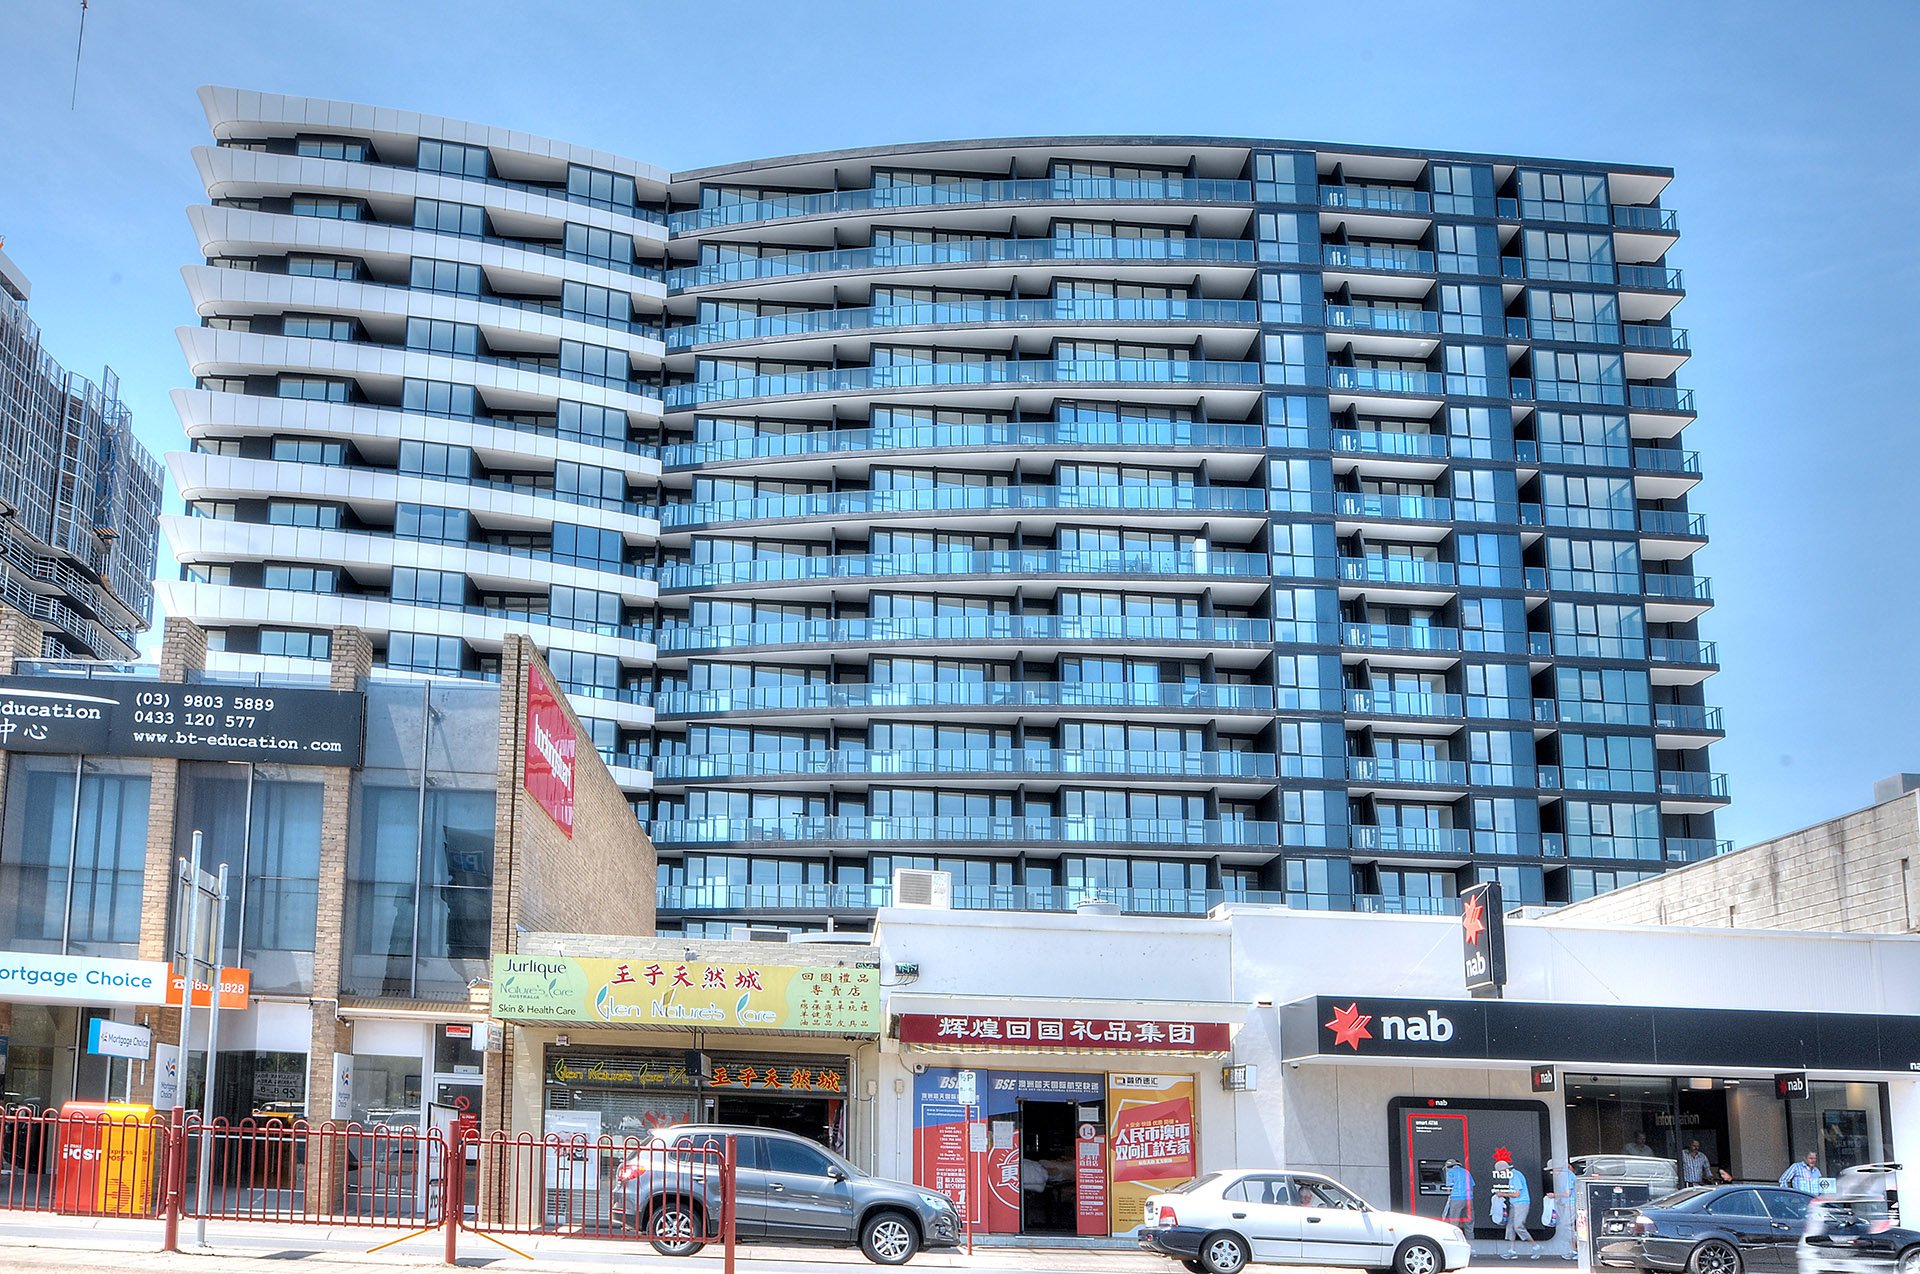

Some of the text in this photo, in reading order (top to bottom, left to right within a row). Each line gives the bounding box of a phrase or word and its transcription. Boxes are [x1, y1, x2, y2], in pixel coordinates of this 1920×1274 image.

[0, 700, 101, 719] ducation
[135, 692, 274, 711] (03) 9803 5889
[134, 711, 256, 729] 0433 120 577
[133, 730, 342, 752] www.bt-education.com
[503, 959, 567, 980] Jurlique
[1465, 951, 1486, 978] nab
[86, 970, 152, 988] Choice
[500, 976, 574, 998] Nature's Care
[611, 964, 763, 991] 王子天然城
[498, 1004, 576, 1015] Skin & Health Care
[596, 984, 777, 1026] Glen Nature's Care
[937, 1017, 1196, 1045] 辉煌回国礼品集团
[1381, 1009, 1454, 1042] nab
[108, 1033, 149, 1048] Mortgage Choice
[709, 1066, 841, 1093] 王子天然城
[994, 1079, 1017, 1090] BSE
[1540, 1070, 1553, 1084] nab
[1787, 1076, 1803, 1092] nab
[1082, 1127, 1093, 1137] 14
[1115, 1123, 1190, 1145] 人民币澳币
[63, 1147, 103, 1161] POST
[1115, 1139, 1190, 1161] 双向汇款专家
[1492, 1168, 1513, 1179] nab
